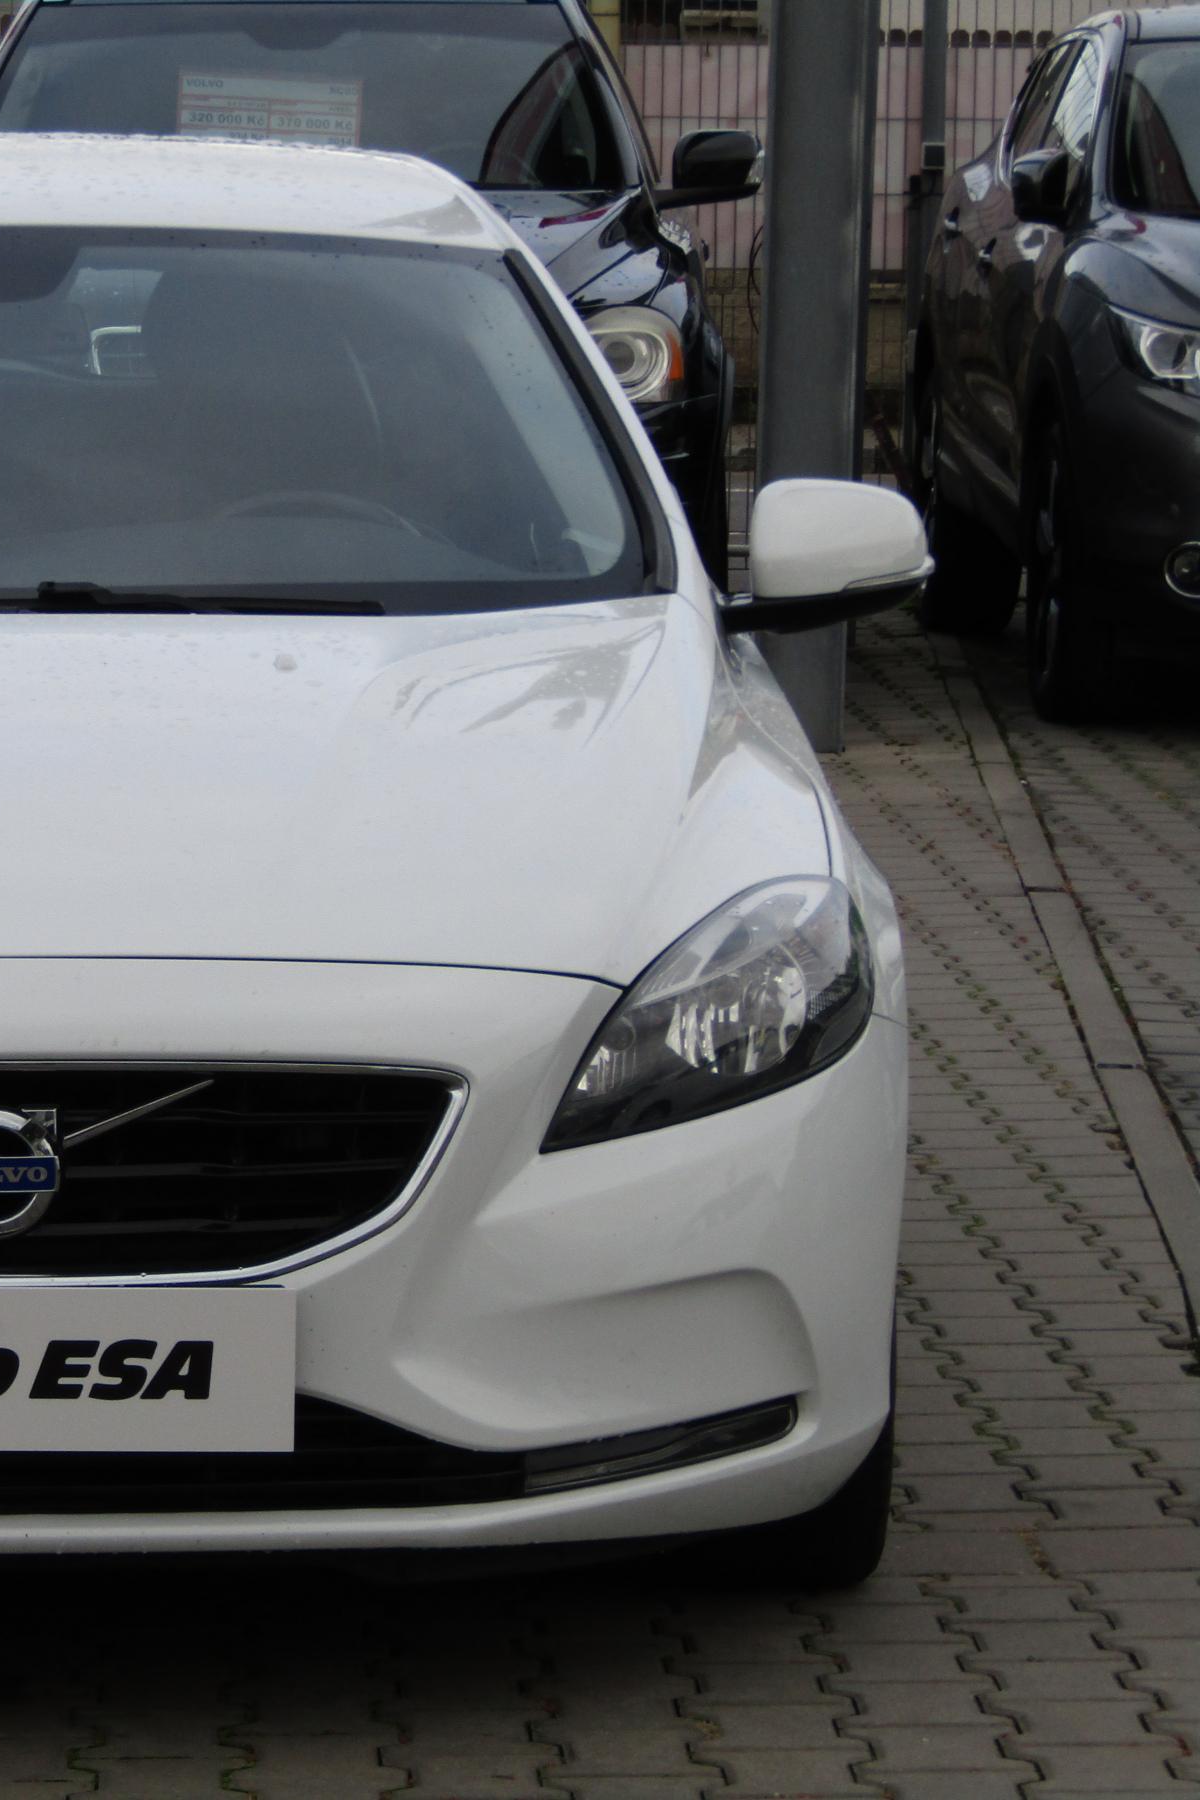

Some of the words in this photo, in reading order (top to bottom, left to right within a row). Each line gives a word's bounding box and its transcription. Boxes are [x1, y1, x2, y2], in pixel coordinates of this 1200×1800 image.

[186, 79, 224, 89] VOLVO
[189, 113, 213, 123] 320
[218, 114, 242, 125] 000
[306, 118, 330, 129] 000
[28, 1339, 214, 1400] ESA
